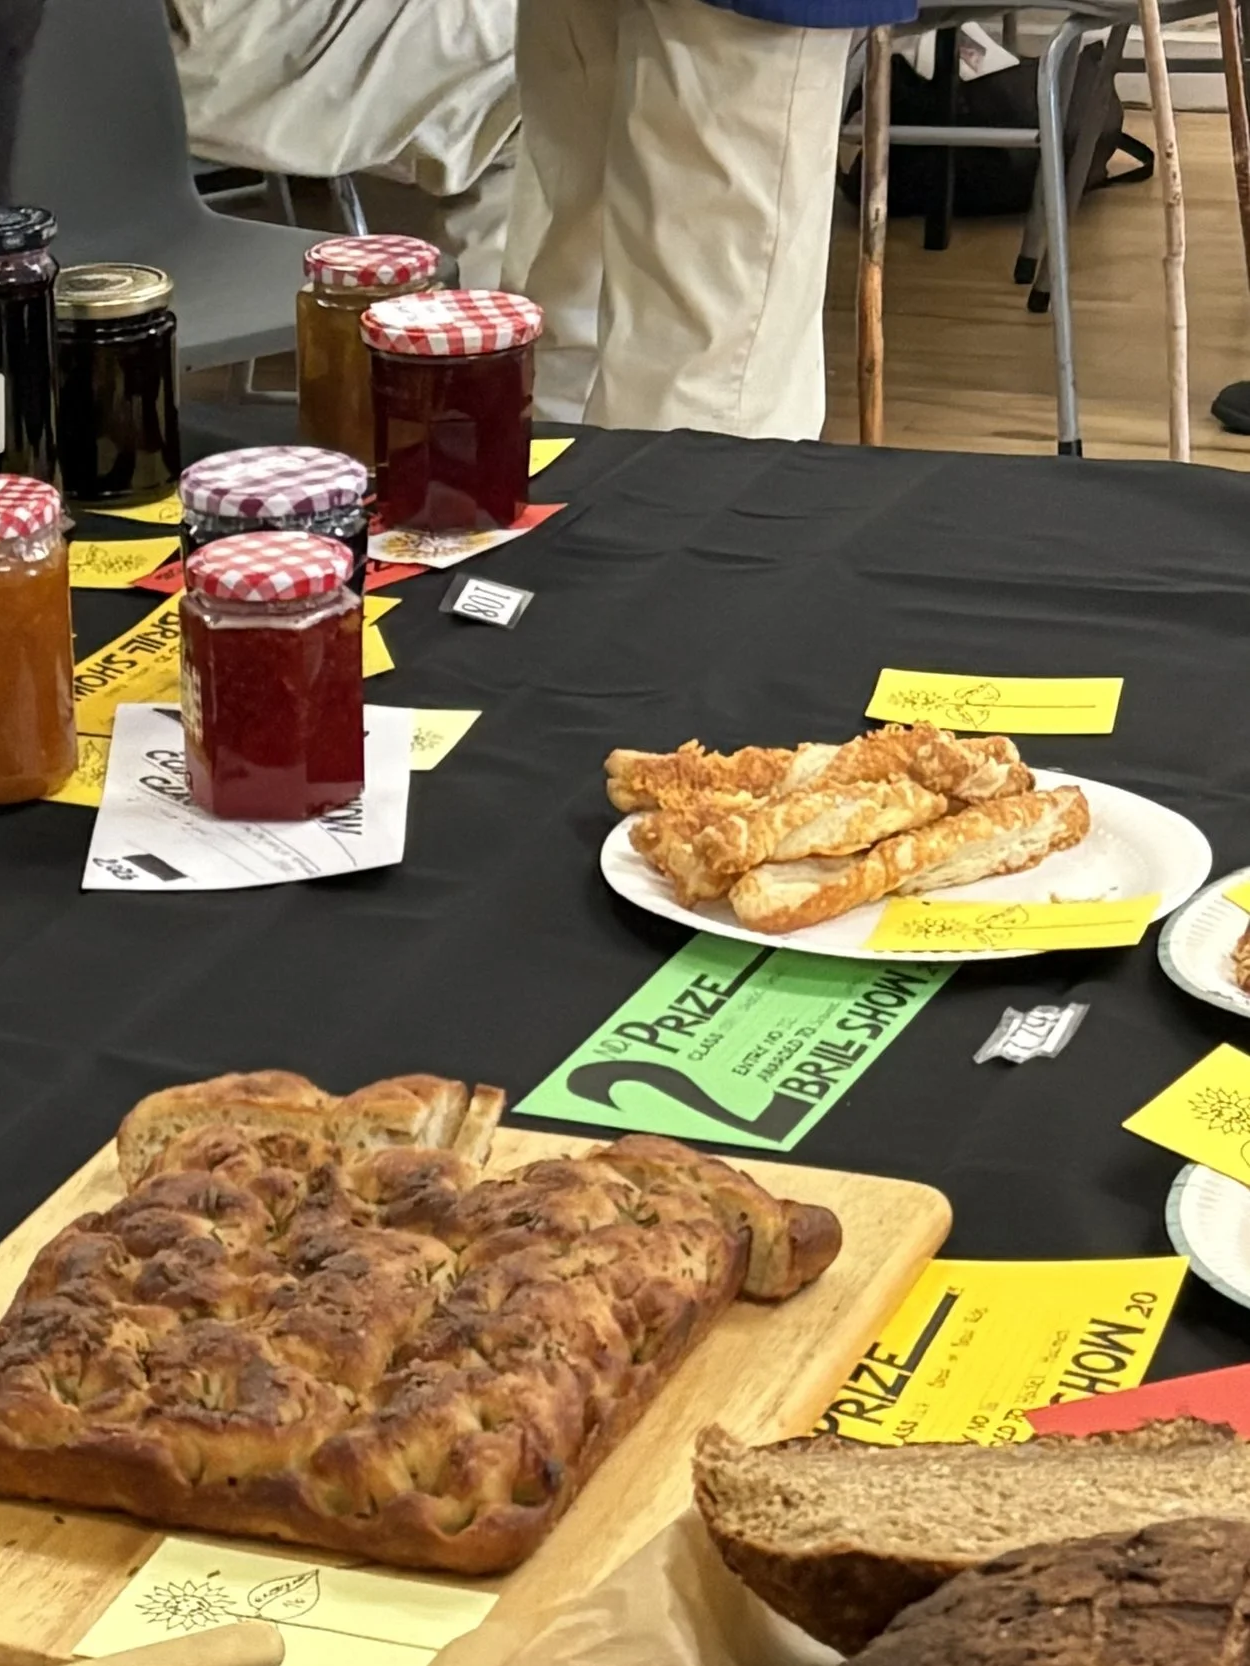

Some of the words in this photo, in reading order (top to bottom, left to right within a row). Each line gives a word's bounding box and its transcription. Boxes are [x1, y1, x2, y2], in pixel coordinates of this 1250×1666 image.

[462, 585, 513, 618] 108
[612, 973, 730, 1054] PRIZE
[778, 1030, 869, 1102] BRILL
[836, 967, 928, 1039] SHOW
[1050, 1317, 1146, 1404] HOW
